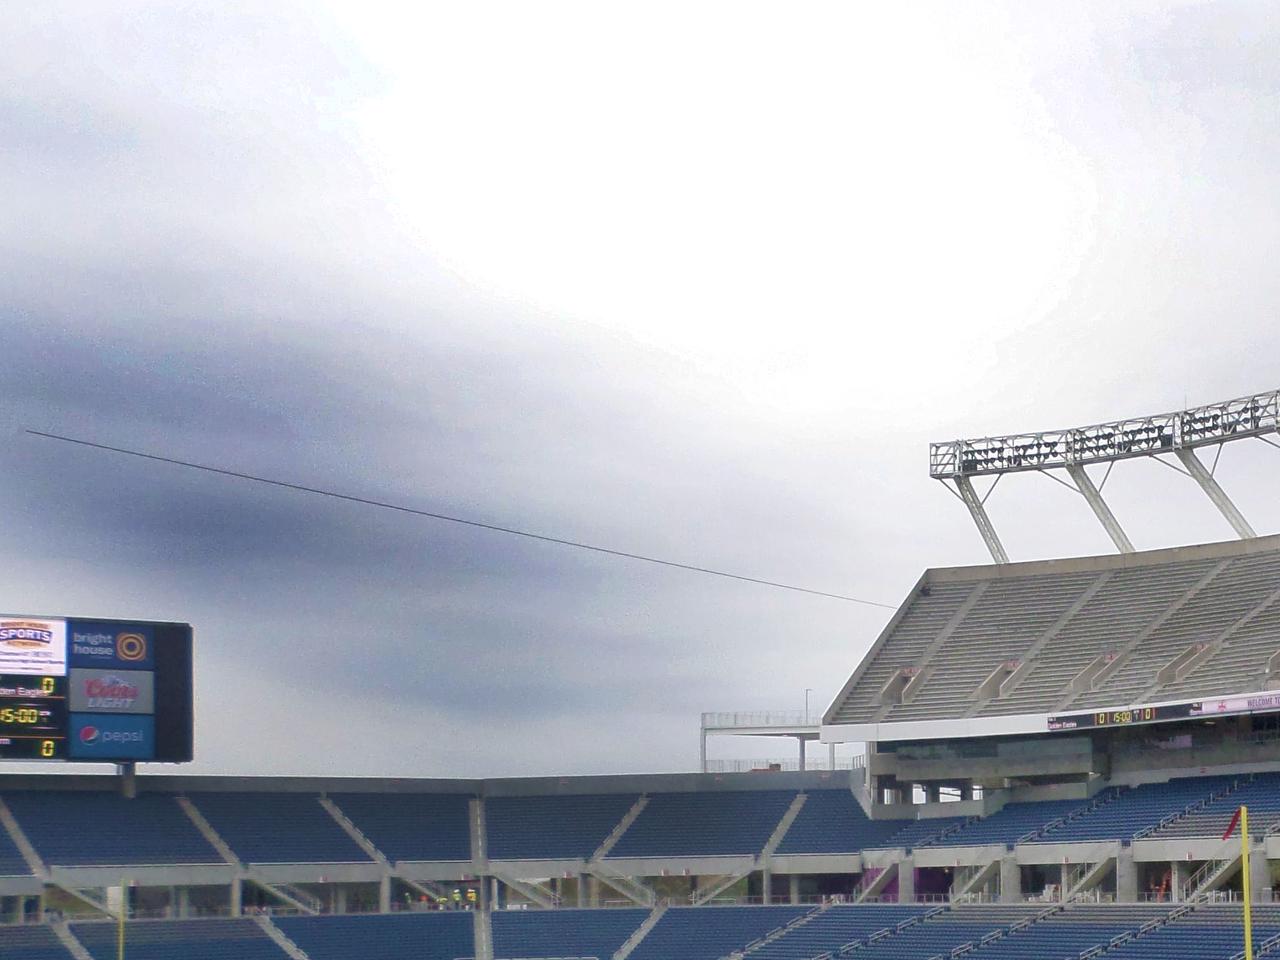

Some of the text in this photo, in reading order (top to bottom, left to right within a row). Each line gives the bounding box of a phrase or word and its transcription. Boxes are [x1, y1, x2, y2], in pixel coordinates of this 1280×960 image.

[0, 629, 50, 642] SPORTS
[73, 633, 112, 645] bright
[73, 644, 113, 655] house
[42, 678, 54, 693] 0
[1247, 698, 1273, 707] WELCOME
[1099, 714, 1105, 724] 0
[1113, 711, 1132, 722] 15:00
[1144, 709, 1151, 720] 0
[102, 730, 143, 743] pepsi
[42, 740, 54, 757] 0
